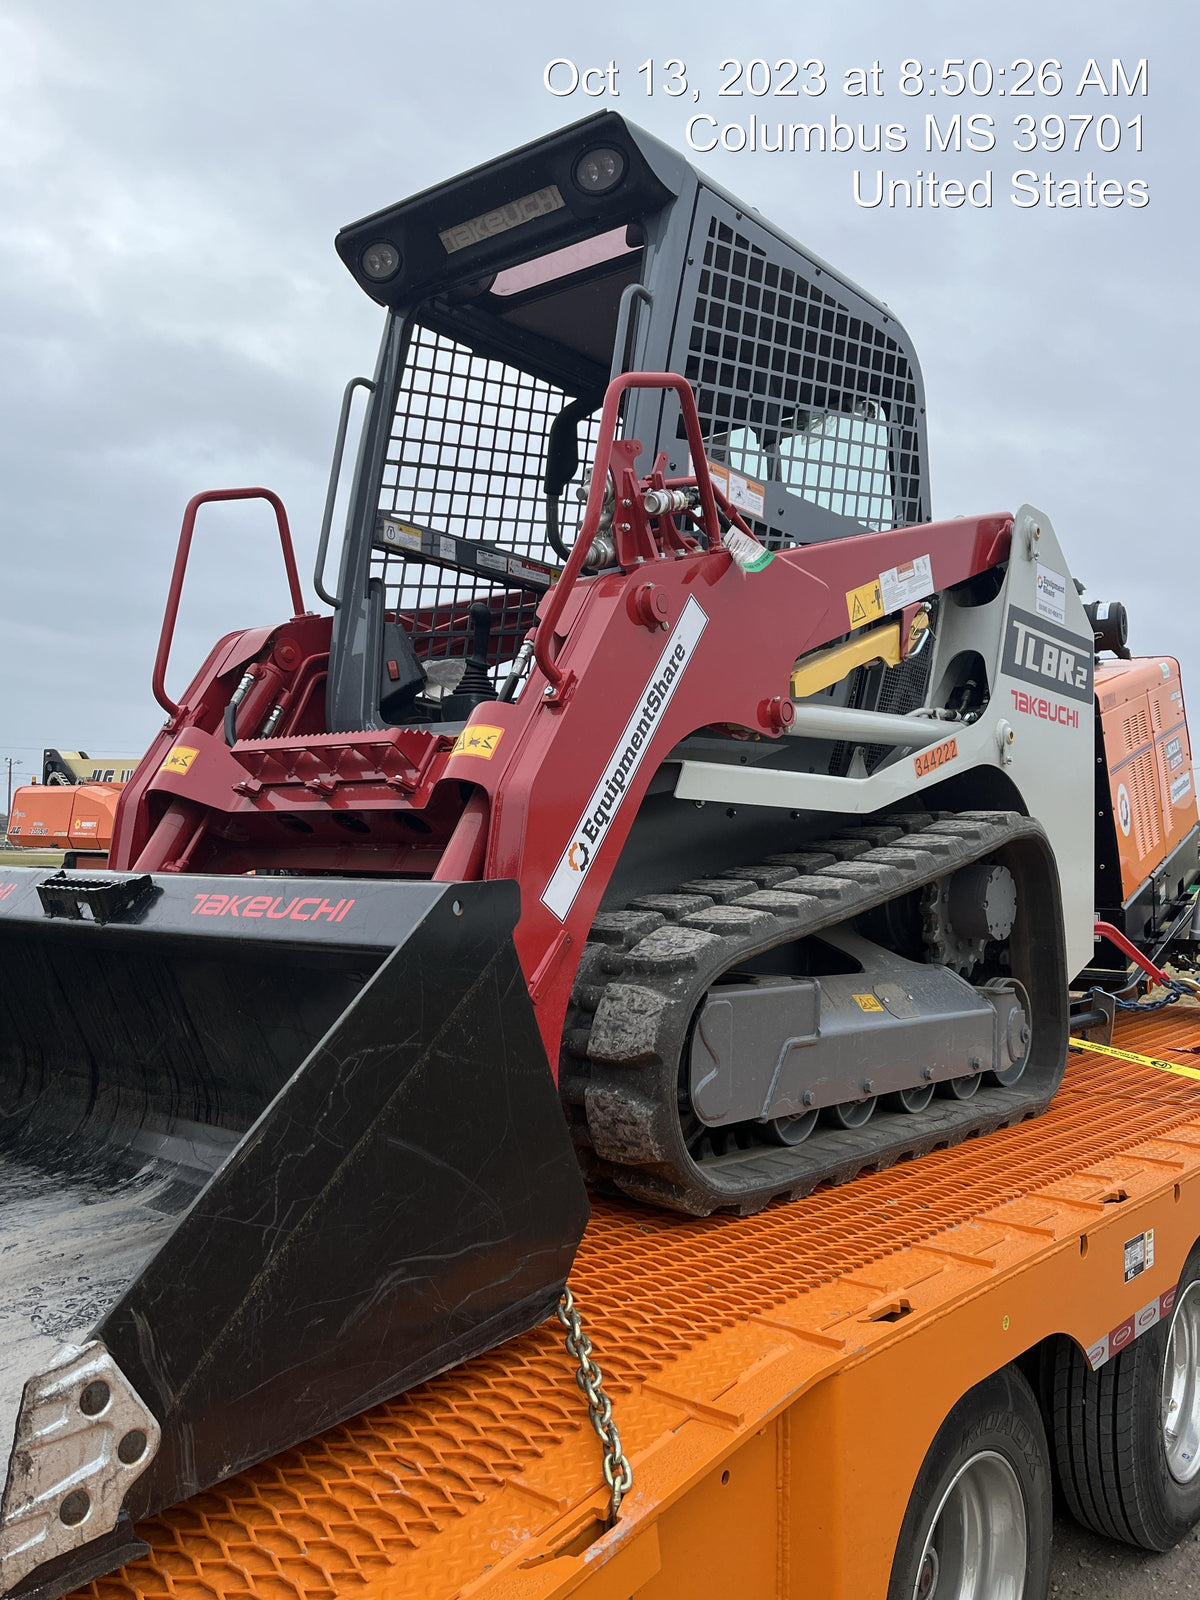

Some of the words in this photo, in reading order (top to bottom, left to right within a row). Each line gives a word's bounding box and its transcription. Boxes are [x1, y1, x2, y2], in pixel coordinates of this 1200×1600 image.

[439, 185, 565, 253] TAKEUCHI
[1011, 689, 1079, 729] TAKEUCHI
[581, 643, 686, 844] EquipmentShare
[915, 740, 957, 777] 344222
[191, 893, 355, 923] TAKEUCHI
